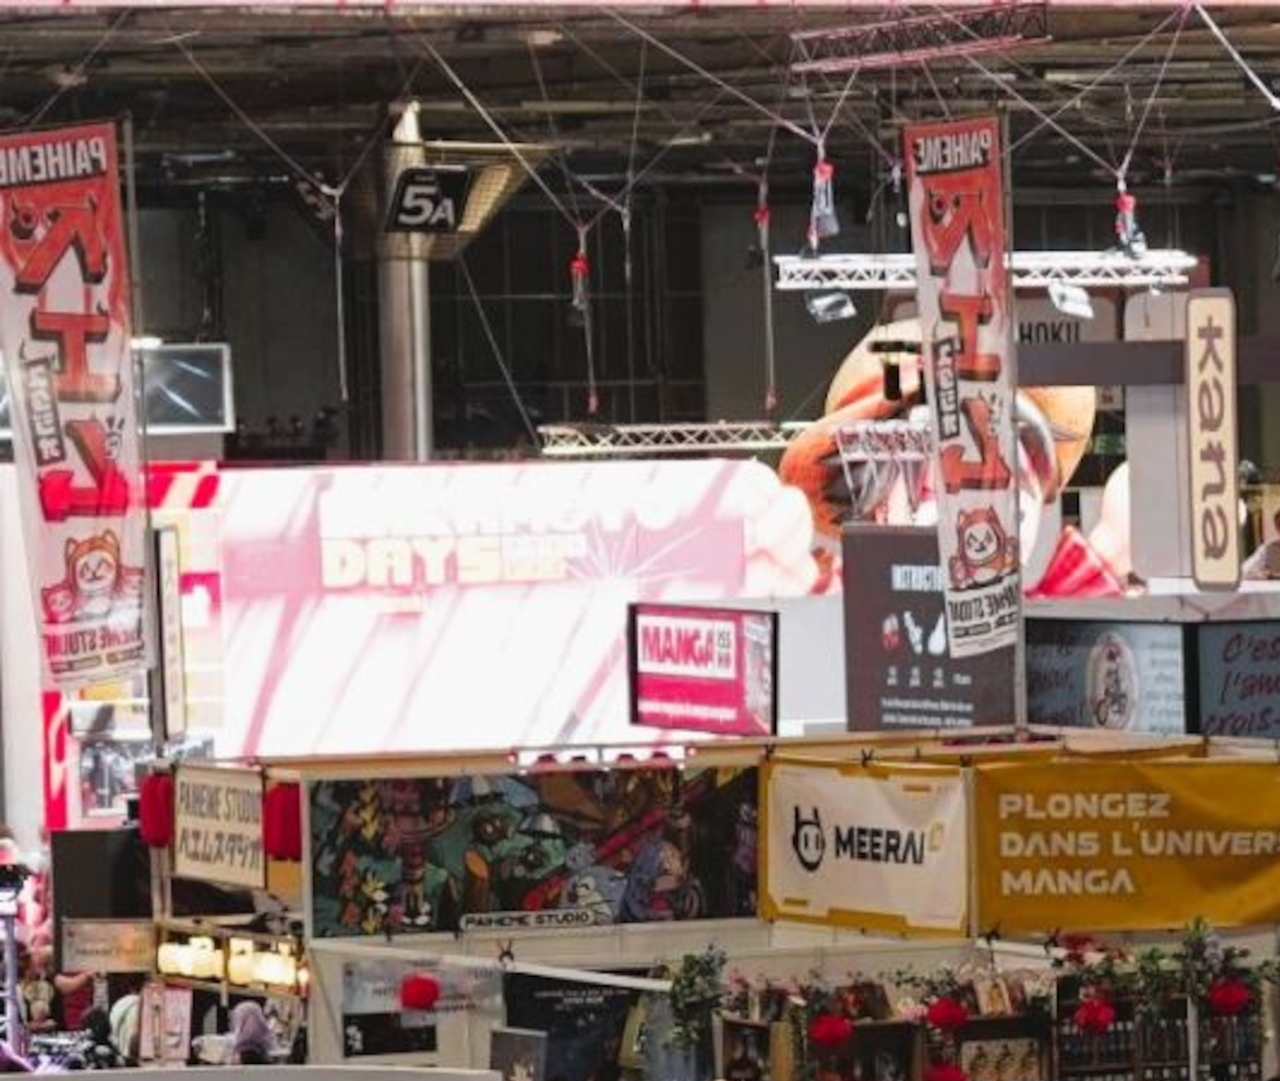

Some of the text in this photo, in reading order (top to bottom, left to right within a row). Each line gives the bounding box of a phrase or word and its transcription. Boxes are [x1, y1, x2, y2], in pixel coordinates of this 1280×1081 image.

[399, 184, 456, 228] 5A
[1197, 314, 1231, 562] kana
[322, 533, 502, 588] DAYS
[641, 625, 715, 668] MANGA
[998, 792, 1172, 821] PLONGEZ
[1000, 829, 1099, 858] DANS
[1000, 869, 1135, 897] MANGA
[535, 912, 590, 925] STUDIO
